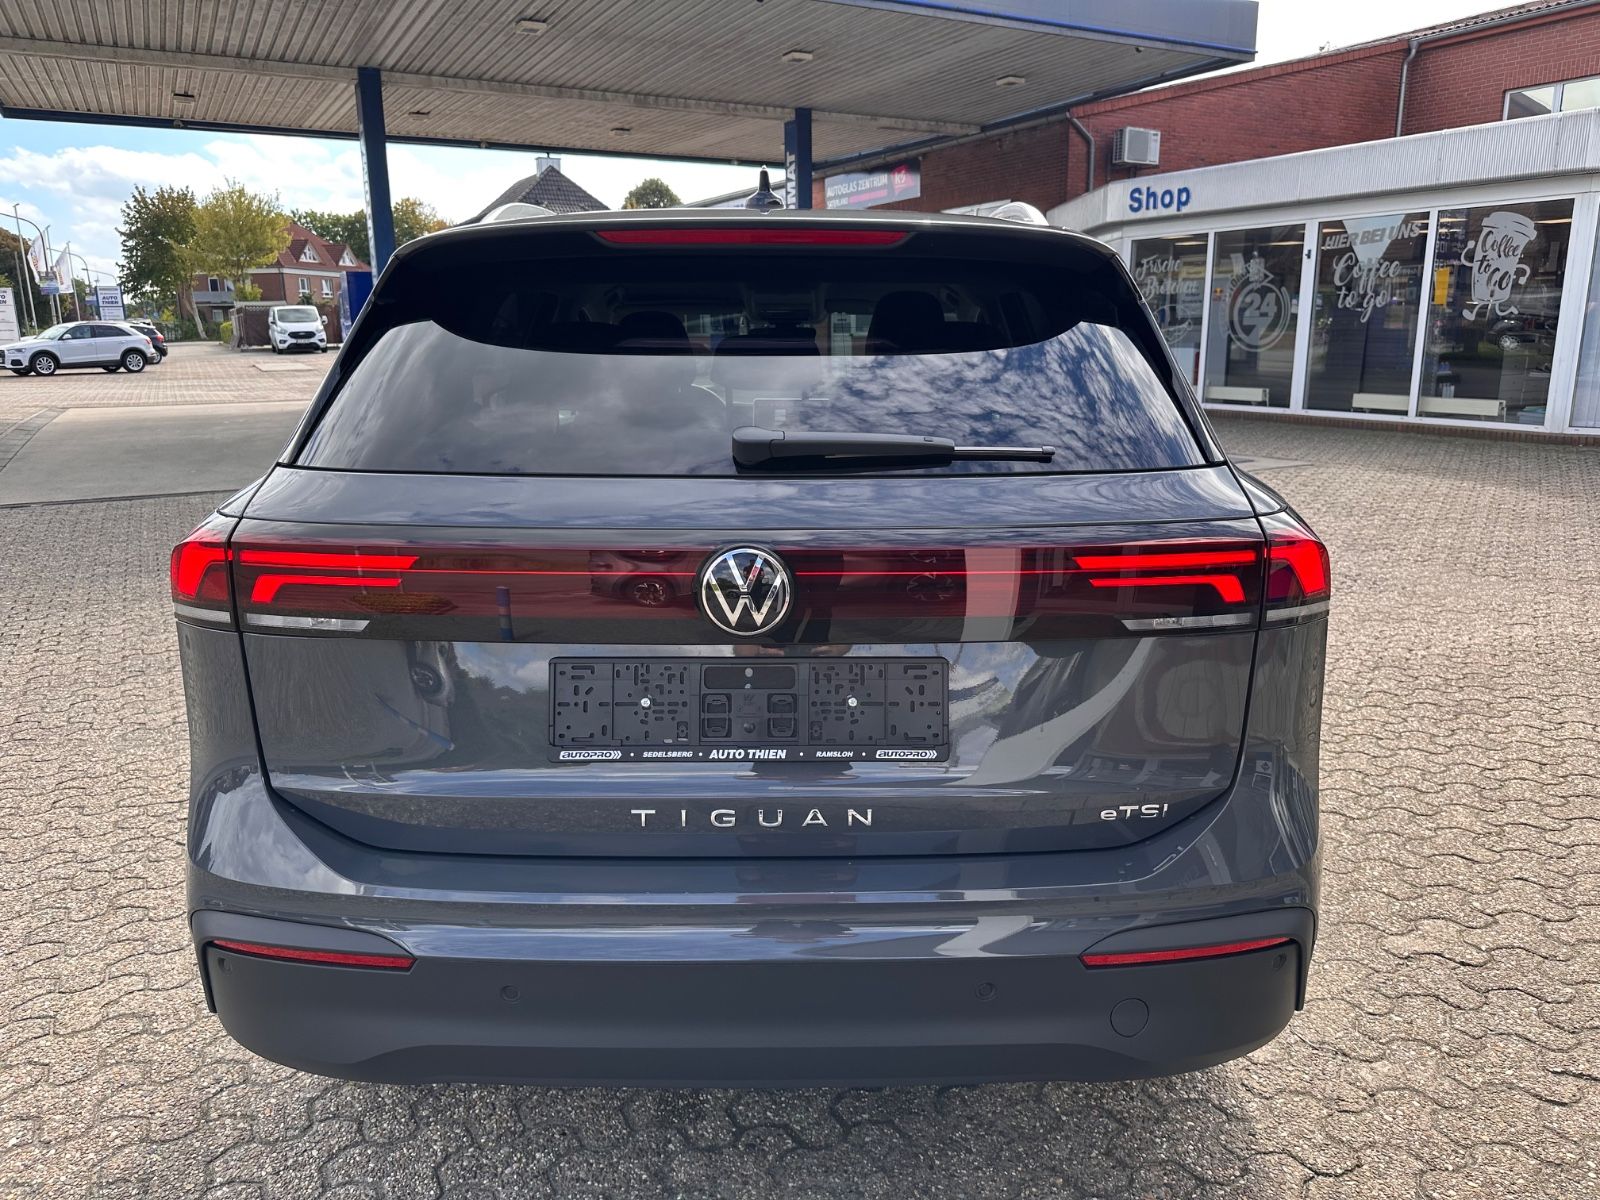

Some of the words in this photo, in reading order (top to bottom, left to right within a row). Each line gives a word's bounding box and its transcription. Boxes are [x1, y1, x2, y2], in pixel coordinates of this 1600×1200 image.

[826, 181, 857, 198] AUTOGLAS
[858, 173, 888, 191] ZENTRUM
[1129, 186, 1191, 213] Shop
[1324, 232, 1359, 250] HIER
[1360, 227, 1387, 246] BEI
[1388, 222, 1422, 241] UNS
[1136, 254, 1181, 281] Frische
[1333, 252, 1401, 295] Coffee
[1242, 292, 1278, 326] 24
[1337, 286, 1359, 309] to
[709, 749, 745, 759] AUTO
[747, 749, 787, 759] THIEN
[630, 808, 873, 828] TIGUAN
[1100, 803, 1169, 821] eTSI
